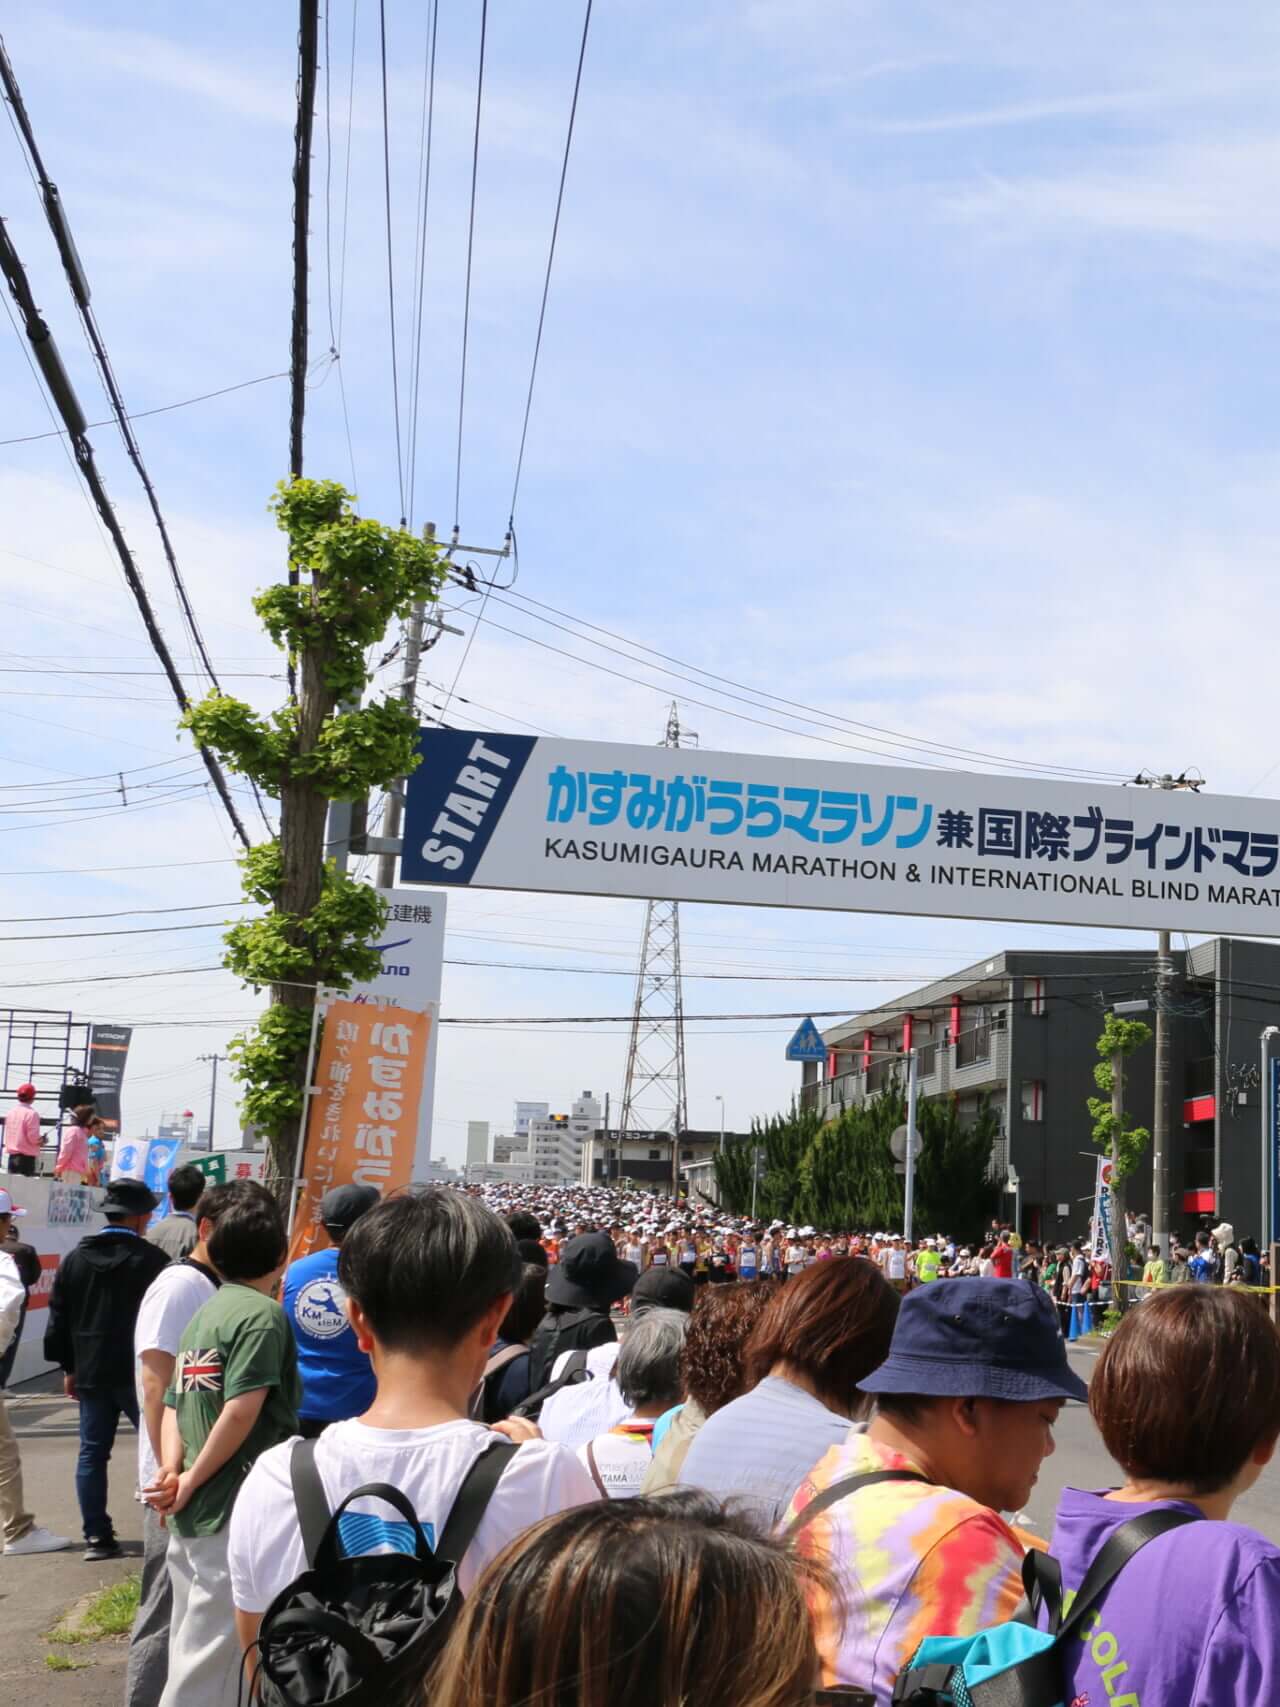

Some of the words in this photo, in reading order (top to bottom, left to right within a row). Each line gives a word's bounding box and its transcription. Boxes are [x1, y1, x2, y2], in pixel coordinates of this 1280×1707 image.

[422, 738, 511, 871] START
[545, 838, 744, 870] KASUMIGAURA
[752, 853, 896, 881] MARATHON
[905, 864, 922, 883] &
[931, 865, 1124, 896] INTERNATIONAL
[1132, 880, 1199, 901] BLIND
[380, 904, 432, 924] 立建機
